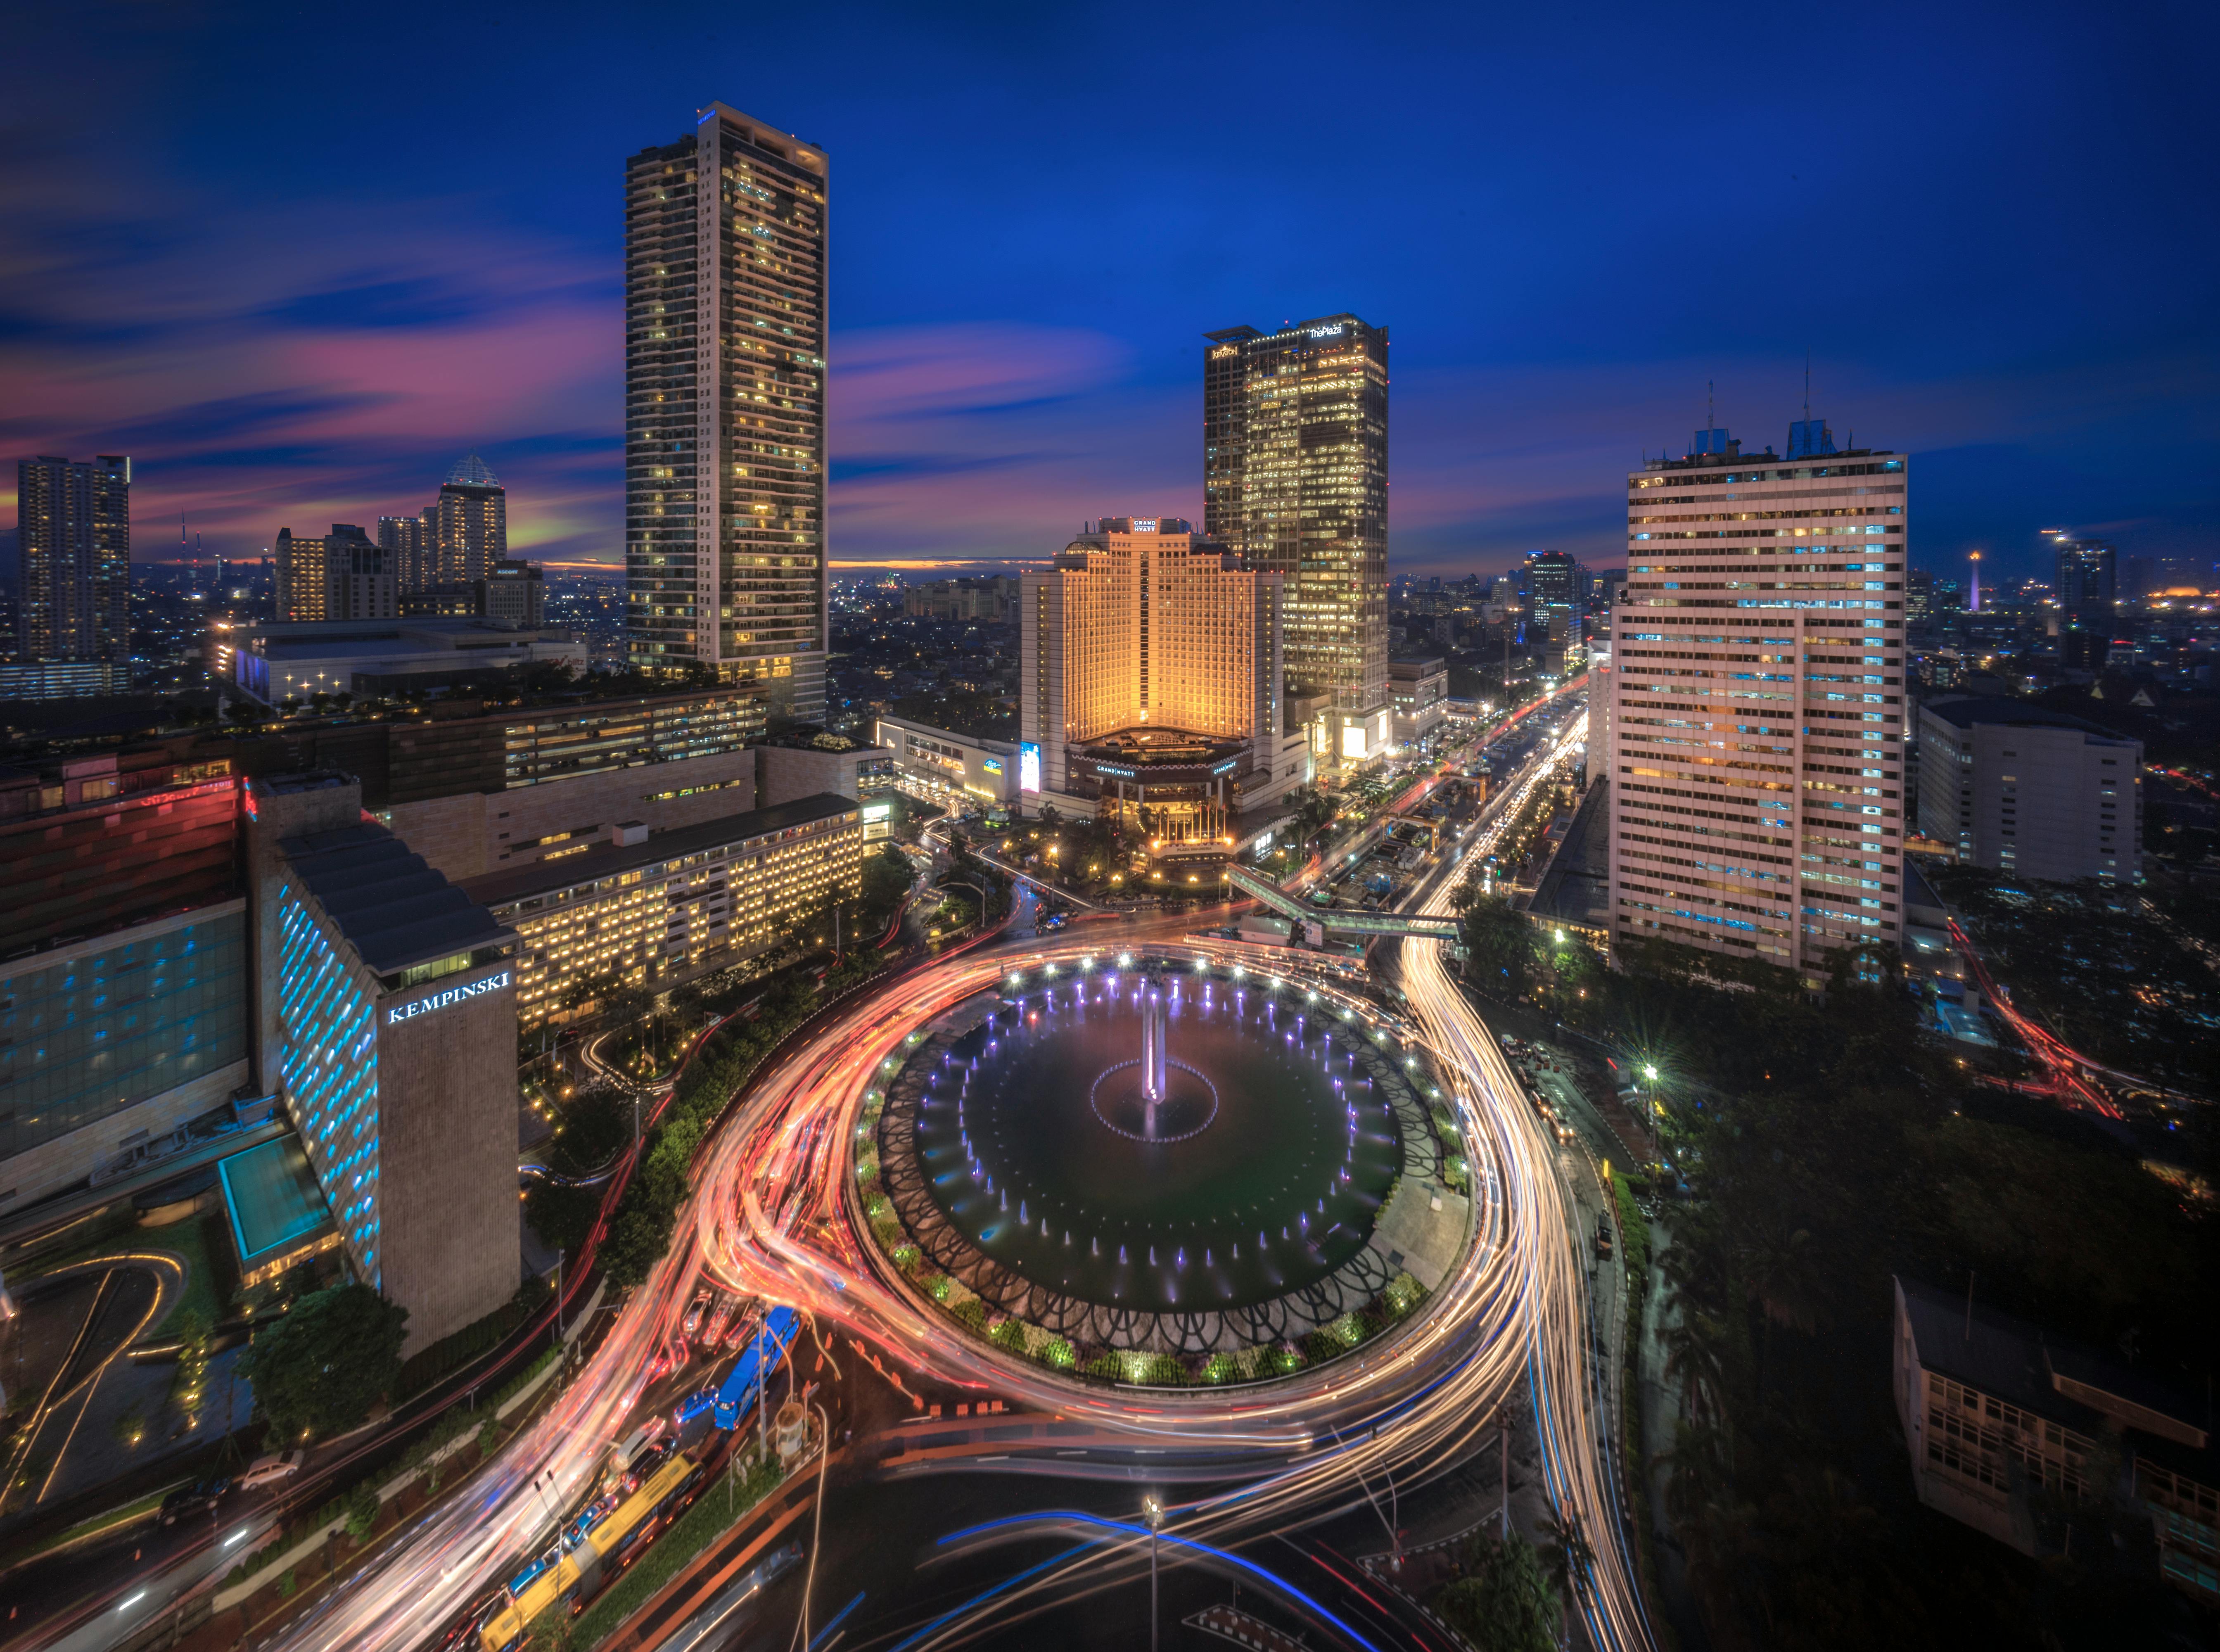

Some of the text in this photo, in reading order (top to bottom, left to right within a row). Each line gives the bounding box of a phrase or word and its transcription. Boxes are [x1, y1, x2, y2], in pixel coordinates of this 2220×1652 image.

[1212, 346, 1238, 359] KERATON
[568, 658, 584, 666] blitz
[388, 972, 508, 1024] KEMPINSKI
